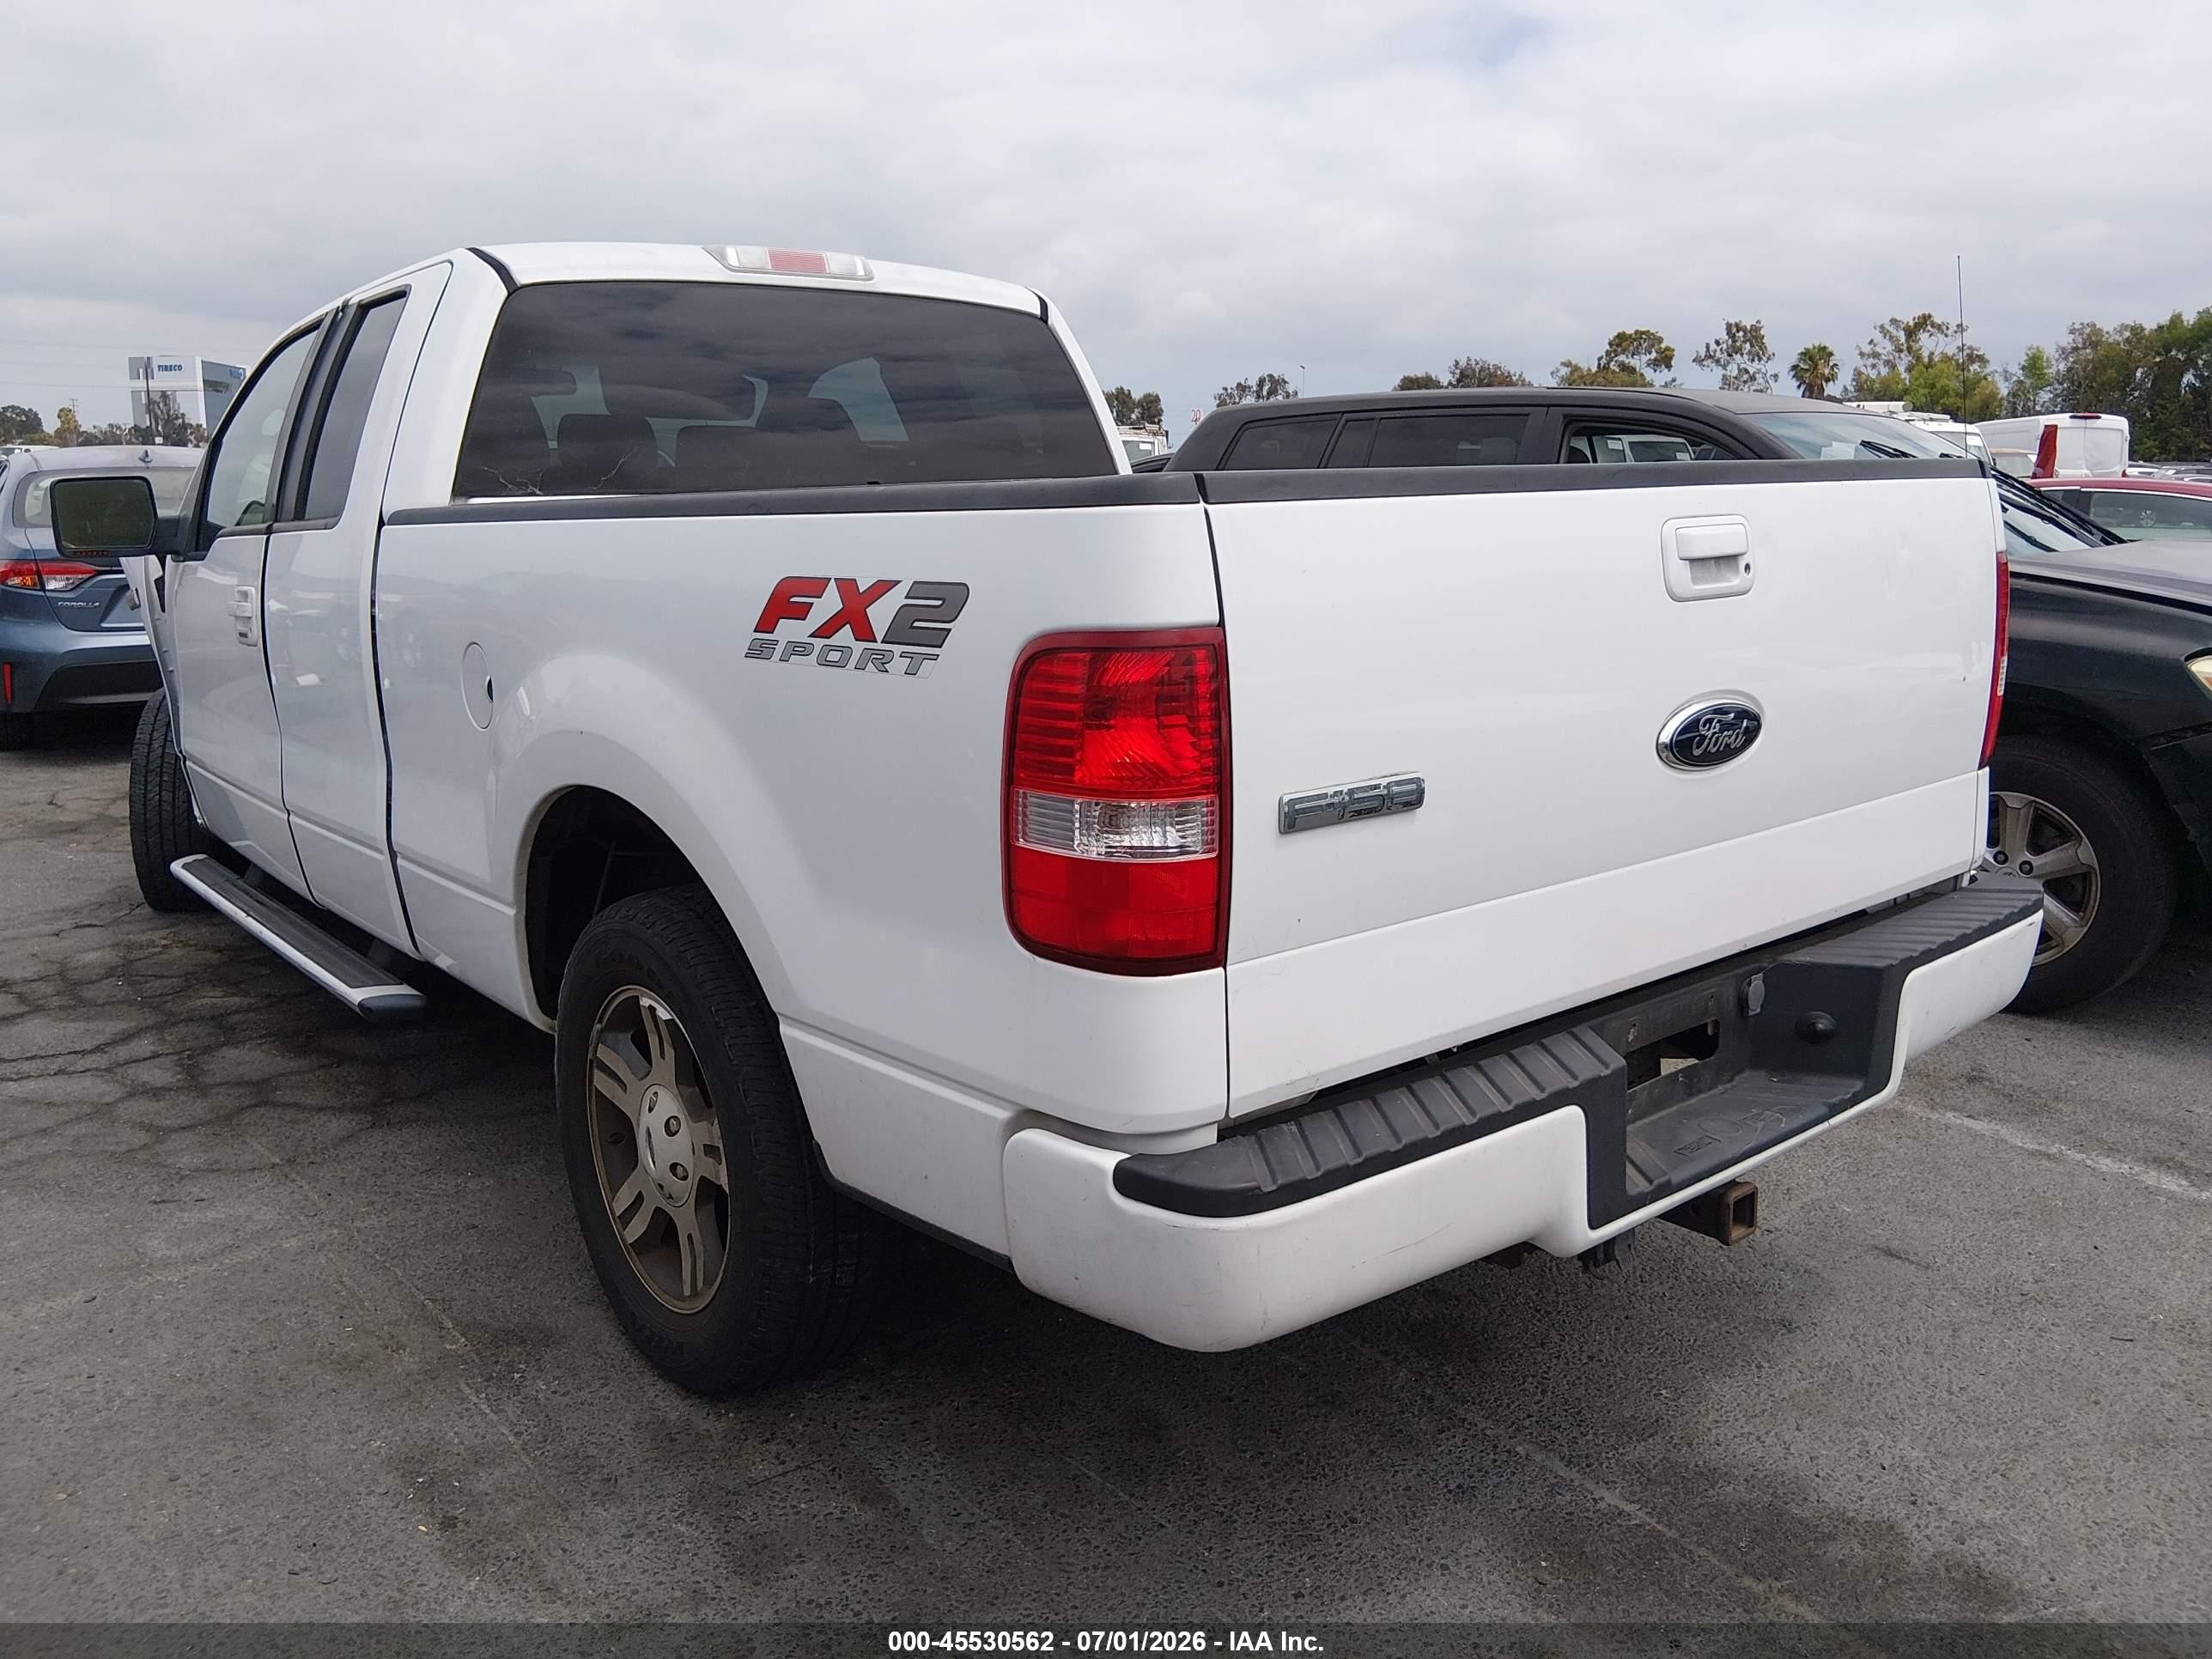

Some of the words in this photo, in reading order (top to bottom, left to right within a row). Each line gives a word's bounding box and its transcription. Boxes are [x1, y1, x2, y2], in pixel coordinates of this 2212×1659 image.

[753, 575, 970, 649] FX2
[744, 638, 940, 676] SPORT
[1691, 712, 1748, 757] Ford
